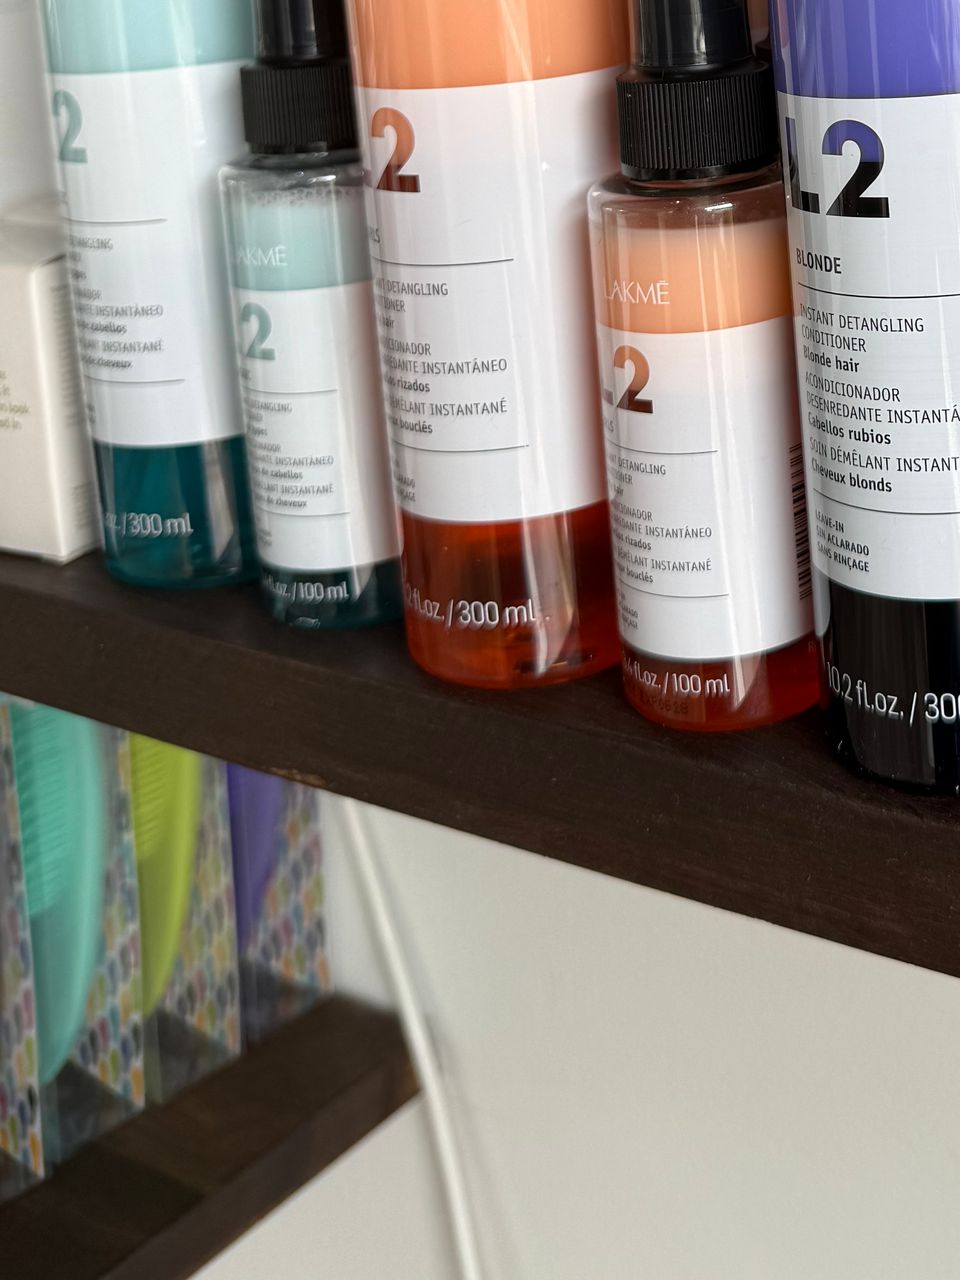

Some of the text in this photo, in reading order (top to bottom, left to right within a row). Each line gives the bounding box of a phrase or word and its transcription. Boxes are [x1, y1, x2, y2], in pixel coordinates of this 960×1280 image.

[53, 89, 88, 164] 2
[371, 106, 422, 194] 2
[784, 116, 891, 219] L2
[796, 247, 842, 275] BLONDE
[387, 279, 449, 297] DETANGLING
[240, 301, 276, 362] 2
[800, 303, 925, 334] INSTANT DETANGLING
[801, 324, 867, 353] CONDITIONER
[422, 357, 508, 375] INSTANTÁNEO
[803, 345, 860, 373] Blonde hair
[397, 377, 431, 393] rizados
[805, 371, 901, 403] ACONDICIONADOR
[431, 397, 508, 417] INSTANTANÉ
[806, 391, 882, 424] DESENREDANTE
[400, 417, 433, 434] bouclés
[807, 412, 892, 446] Cabellos rubios
[810, 435, 828, 459] SOIN
[830, 445, 891, 472] DÉMÊLANT
[618, 459, 667, 476] DETANGLING
[811, 457, 892, 493] Cheveux blonds
[128, 512, 162, 538] 300
[163, 512, 194, 537] ml
[645, 525, 712, 540] INSTANTÁNEO
[815, 508, 845, 533] LEAVE-IN
[625, 536, 652, 551] rizados
[827, 533, 870, 557] ACLARADO
[626, 567, 654, 583] bouclés
[652, 558, 712, 571] INSTANTANÉ
[833, 552, 870, 573] RINÇAGE
[299, 580, 350, 601] 100 ml
[458, 600, 500, 625] 300
[504, 598, 537, 625] ml
[673, 672, 702, 695] 100
[706, 672, 731, 694] ml
[827, 661, 853, 701] 10.2
[855, 679, 904, 720] fl.oz.
